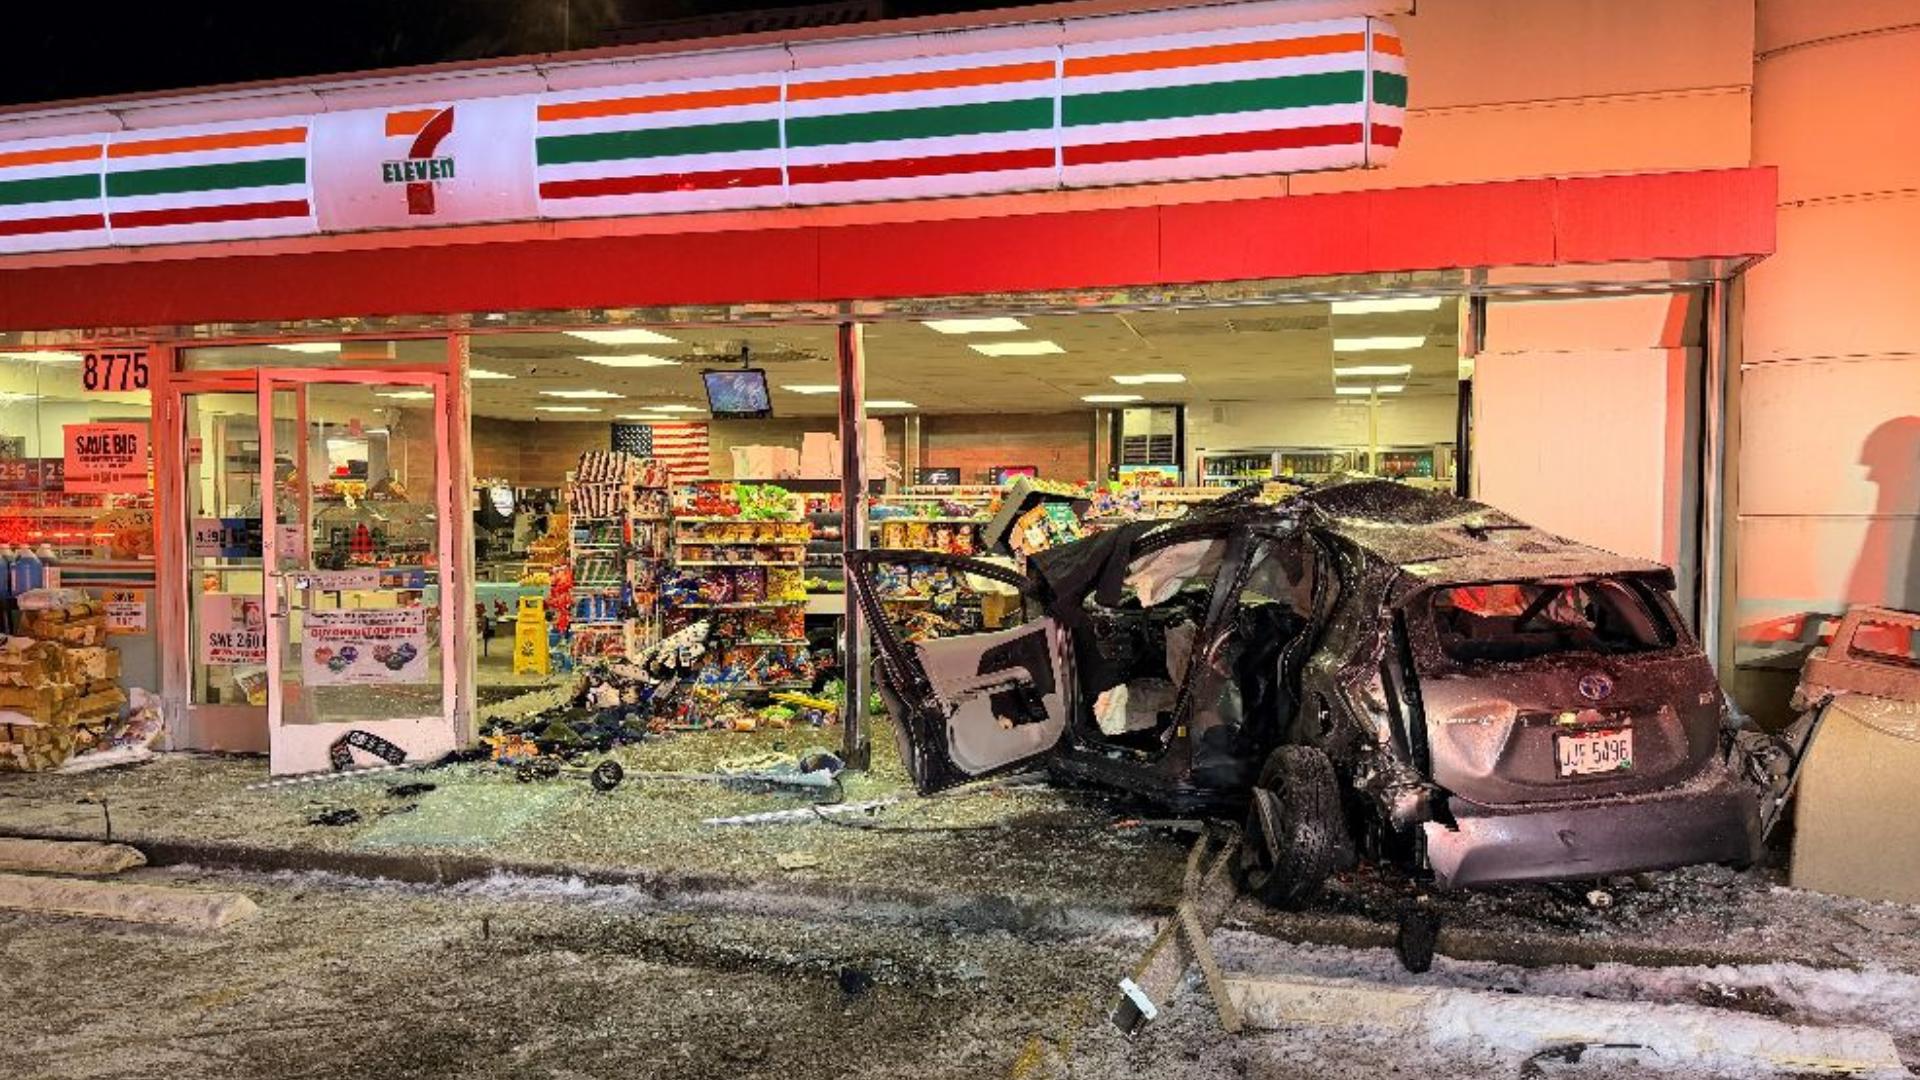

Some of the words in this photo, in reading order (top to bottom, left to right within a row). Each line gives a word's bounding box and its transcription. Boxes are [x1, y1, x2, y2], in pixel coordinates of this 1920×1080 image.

[385, 105, 454, 215] 7
[83, 353, 149, 391] 8775
[76, 434, 111, 455] SAVE
[113, 434, 137, 455] BIG
[1592, 739, 1630, 764] 5496
